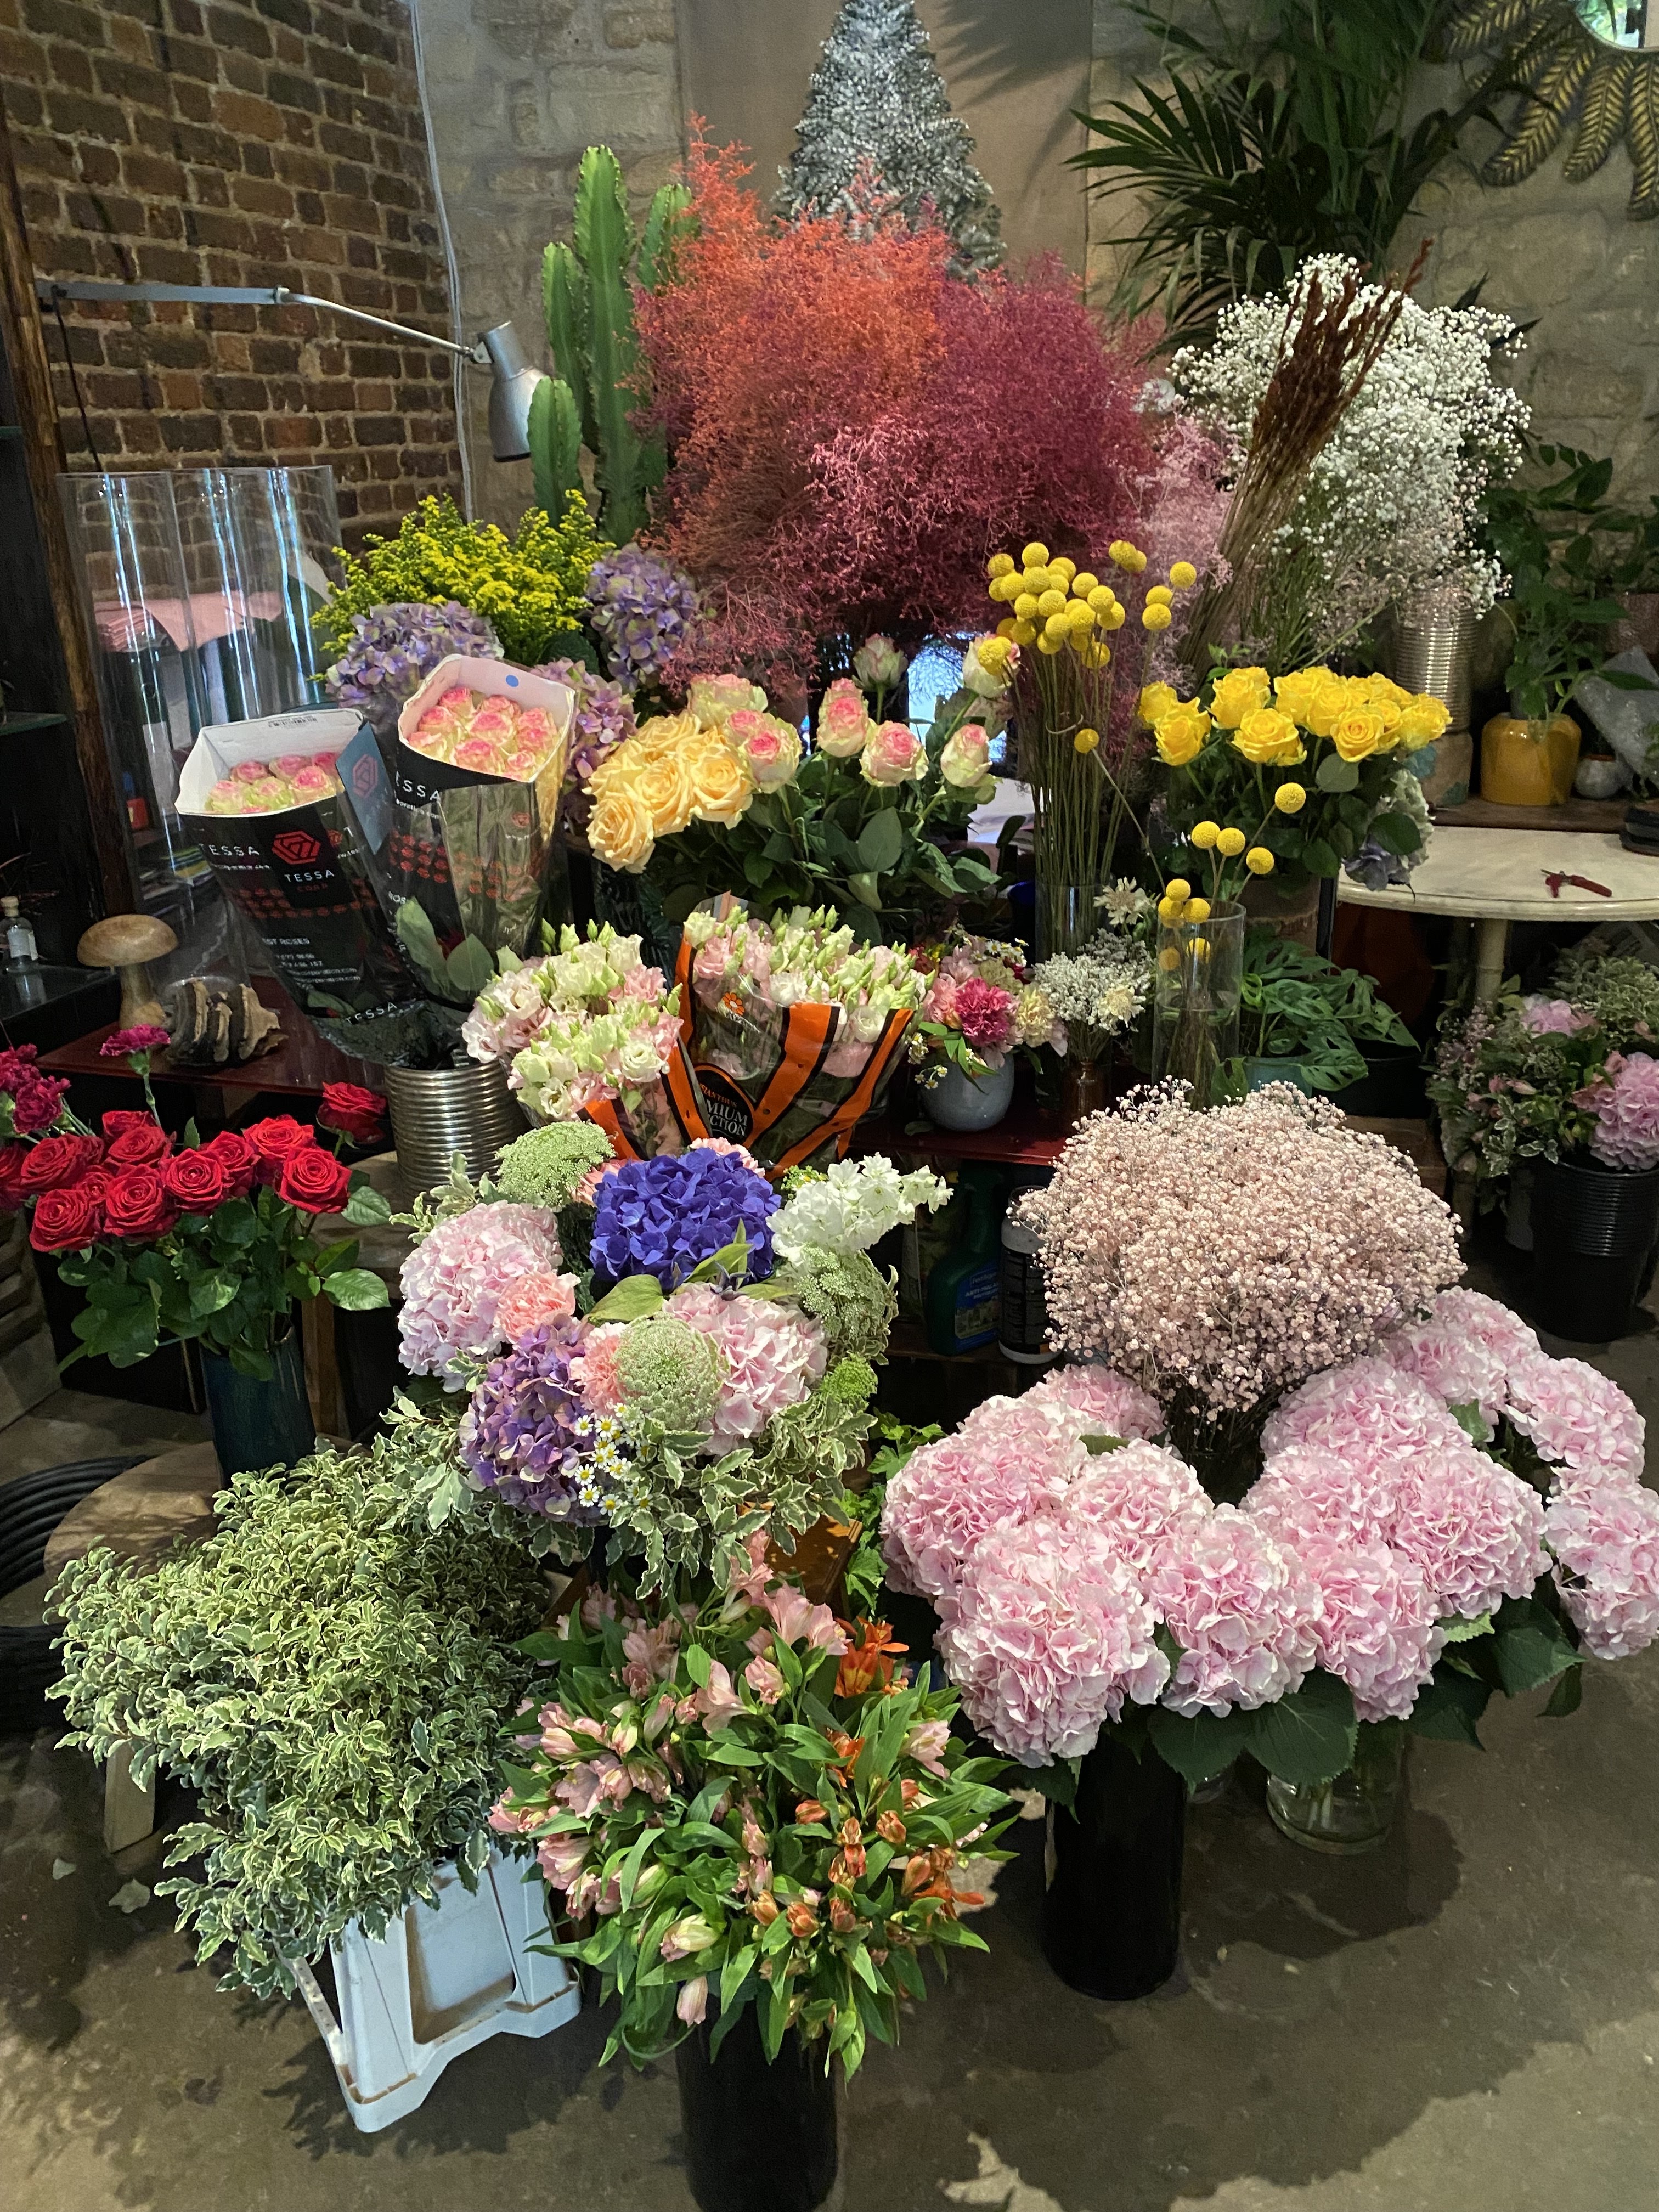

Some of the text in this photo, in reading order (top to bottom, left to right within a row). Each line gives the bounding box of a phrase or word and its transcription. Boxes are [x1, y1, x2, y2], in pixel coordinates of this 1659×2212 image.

[284, 869, 335, 882] TESSA
[345, 1001, 398, 1025] TESSA
[706, 1098, 748, 1127] MIUM
[708, 1114, 747, 1137] CTION
